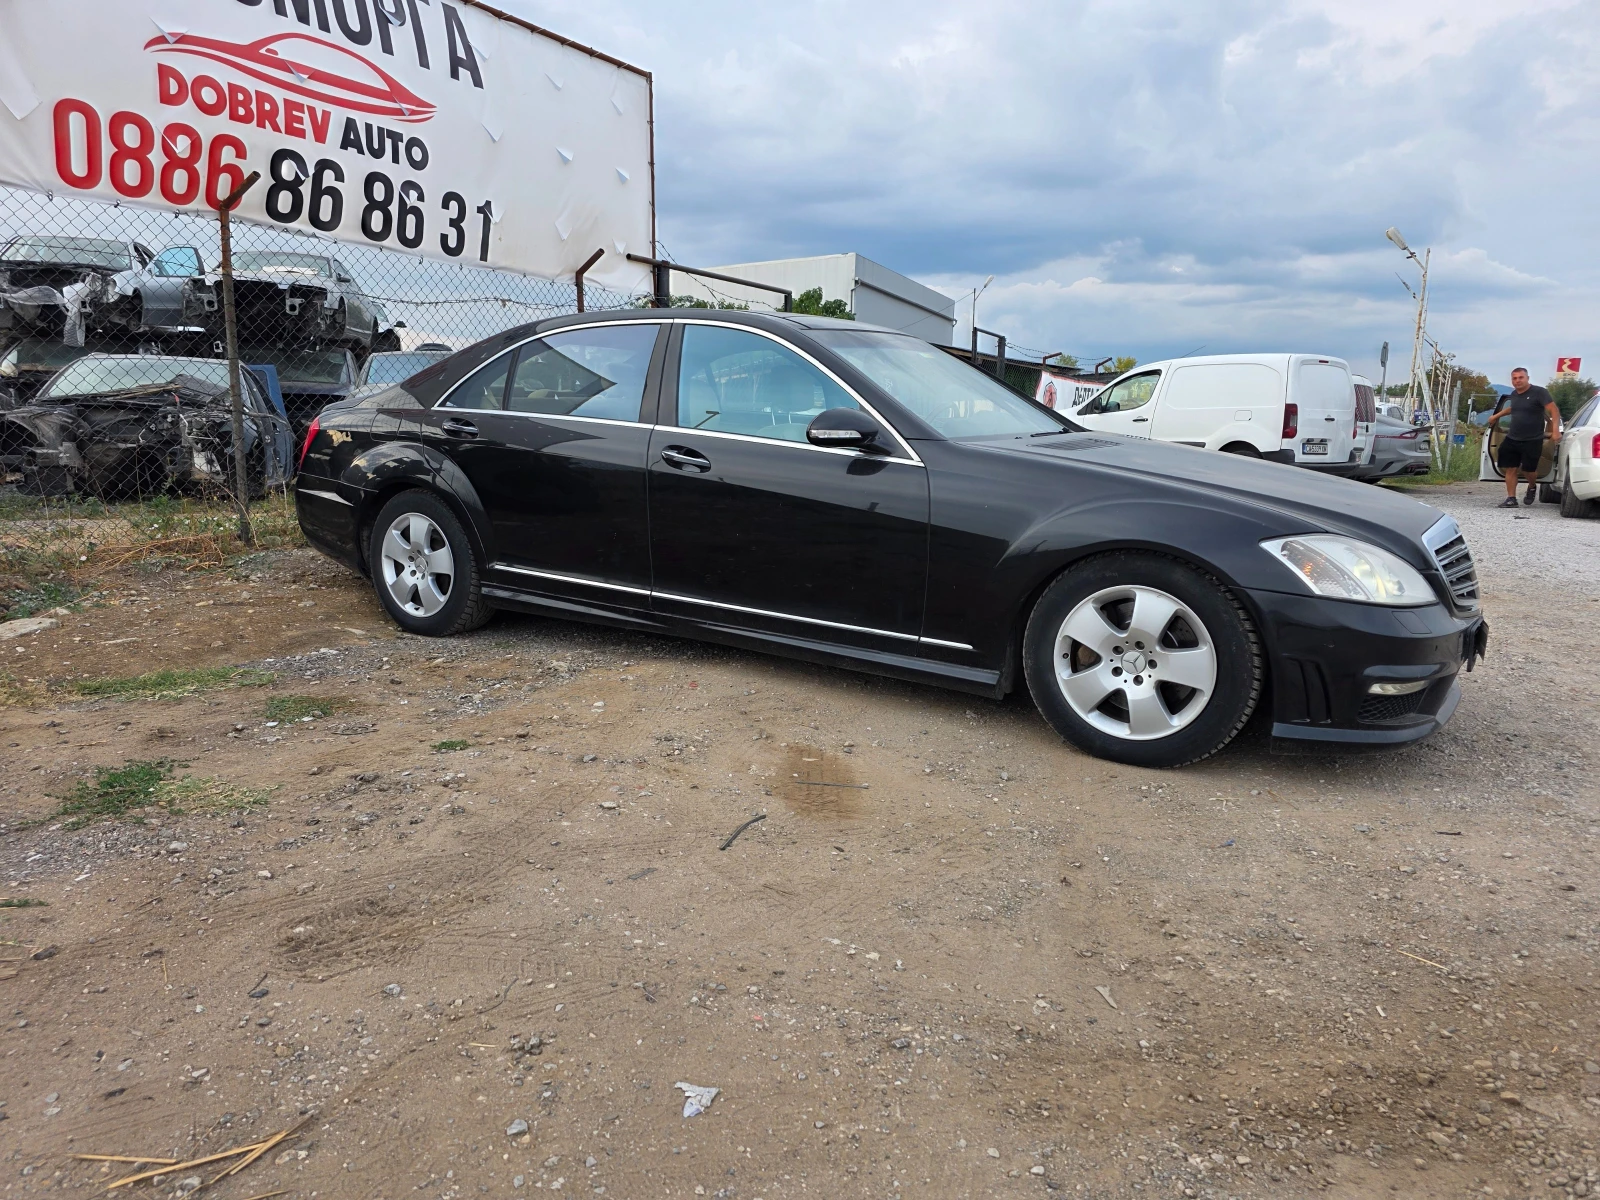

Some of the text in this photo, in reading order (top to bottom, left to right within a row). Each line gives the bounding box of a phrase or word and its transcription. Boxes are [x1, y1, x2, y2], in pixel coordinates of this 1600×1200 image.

[53, 97, 493, 263] 0886 86 86 31
[157, 62, 430, 172] DOBREV AUTO
